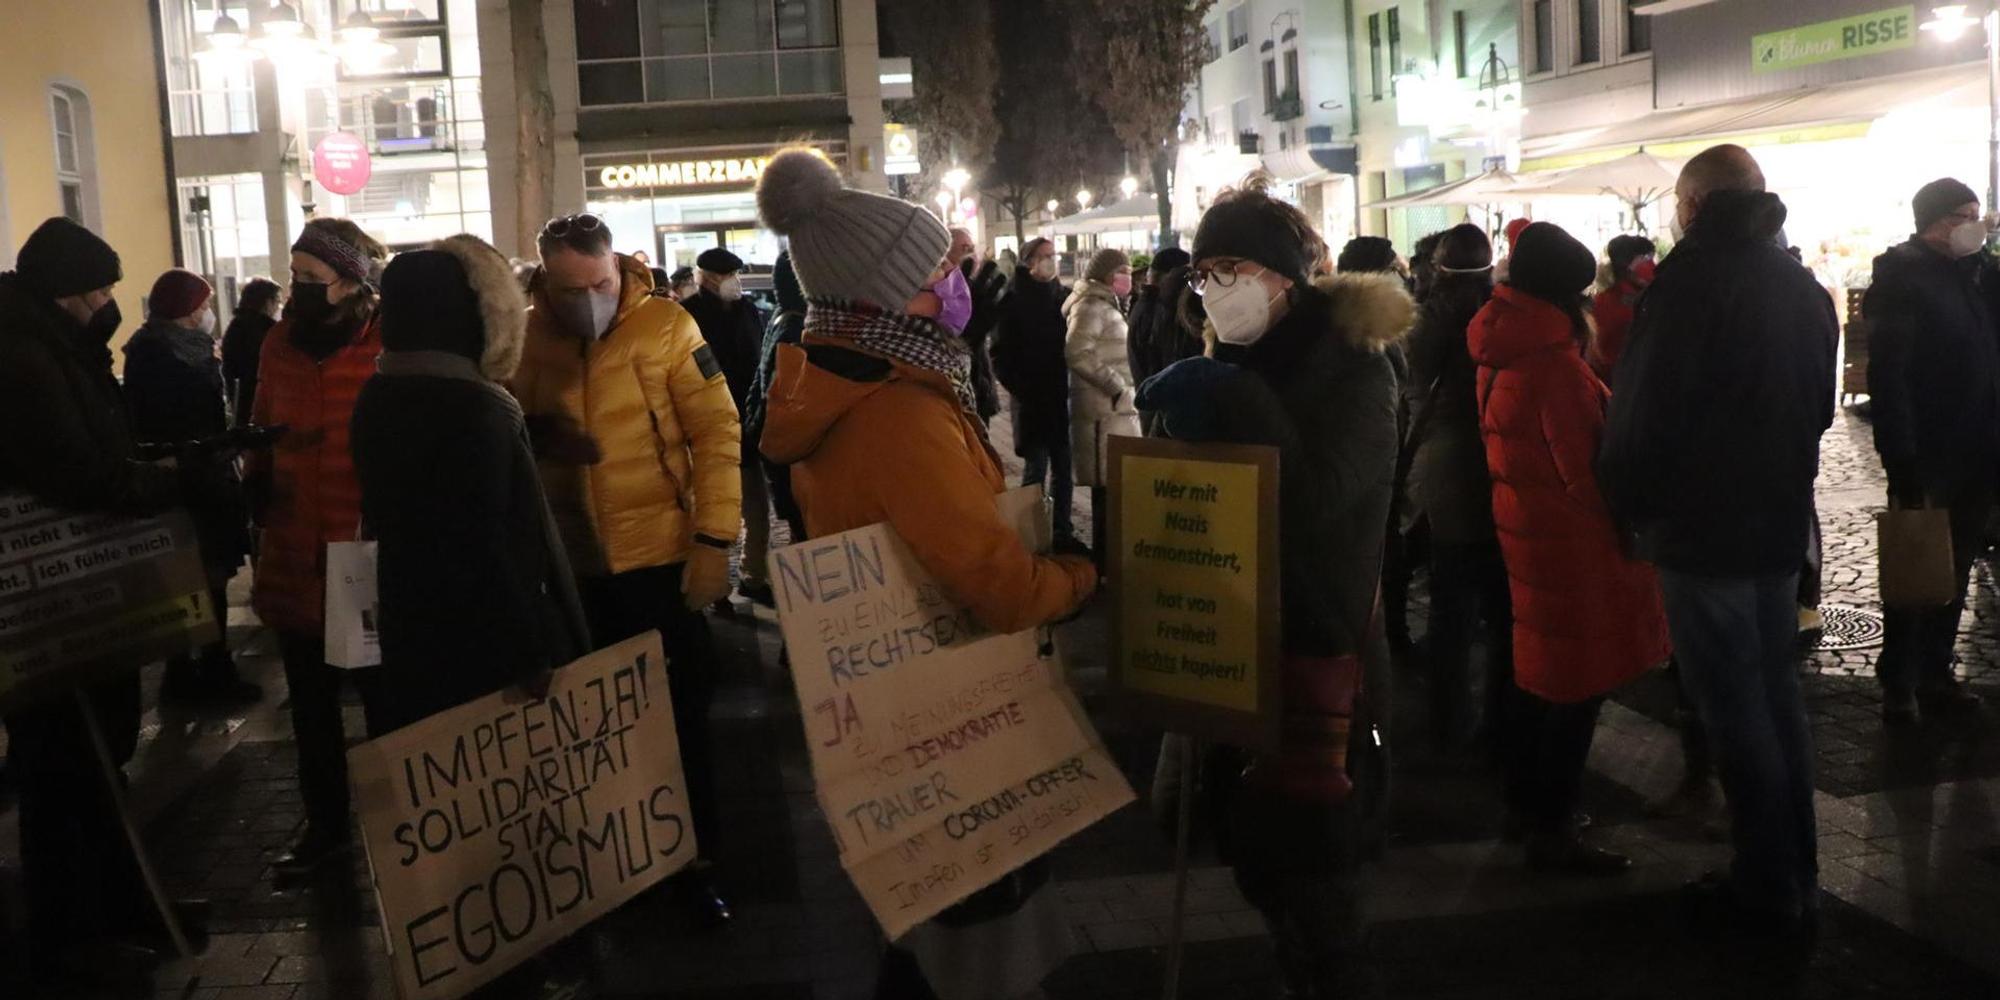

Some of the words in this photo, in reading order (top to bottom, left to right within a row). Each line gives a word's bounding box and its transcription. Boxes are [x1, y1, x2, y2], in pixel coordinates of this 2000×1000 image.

[1841, 15, 1909, 50] RISSE
[1153, 478, 1187, 499] Wer
[1189, 484, 1218, 503] mit
[11, 527, 61, 551] nicht
[1165, 511, 1208, 534] Nazis
[39, 560, 70, 579] Ich
[127, 534, 171, 556] mich
[776, 533, 885, 612] NEIN
[1133, 539, 1241, 574] demonstriert,
[1155, 588, 1182, 609] hat
[1186, 594, 1217, 614] von
[1156, 620, 1217, 646] Freiheit
[1131, 648, 1177, 674] nichts
[1181, 654, 1246, 682] kapiert!
[814, 691, 863, 748] JA
[902, 702, 1026, 769] DEMOKRATIE
[394, 724, 635, 867] SOLIDARITÄT
[846, 770, 960, 846] TRAUER
[498, 786, 590, 861] STATT
[406, 785, 684, 988] EGOISMUS
